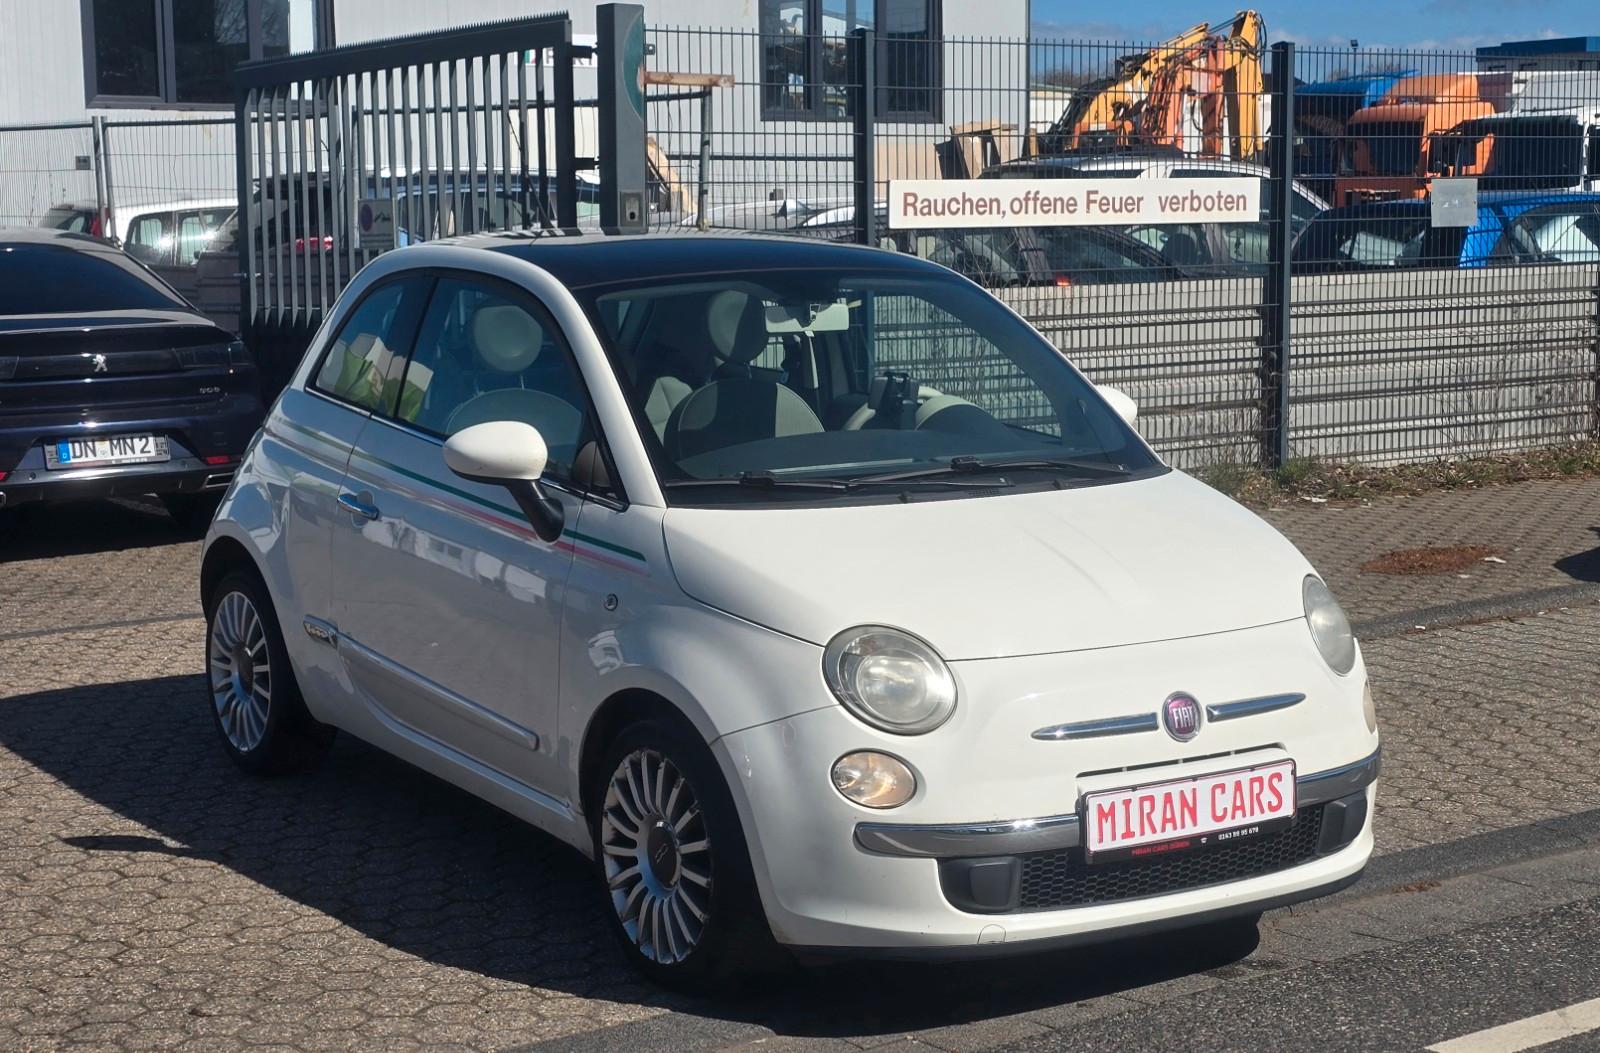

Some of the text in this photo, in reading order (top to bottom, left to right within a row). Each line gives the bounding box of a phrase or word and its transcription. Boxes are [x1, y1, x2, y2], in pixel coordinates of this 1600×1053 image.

[902, 189, 1248, 219] Rauchen, offene Feuer verboten
[71, 440, 97, 458] DN
[1173, 706, 1195, 729] FIAT
[1097, 772, 1283, 843] MIRAN CARS
